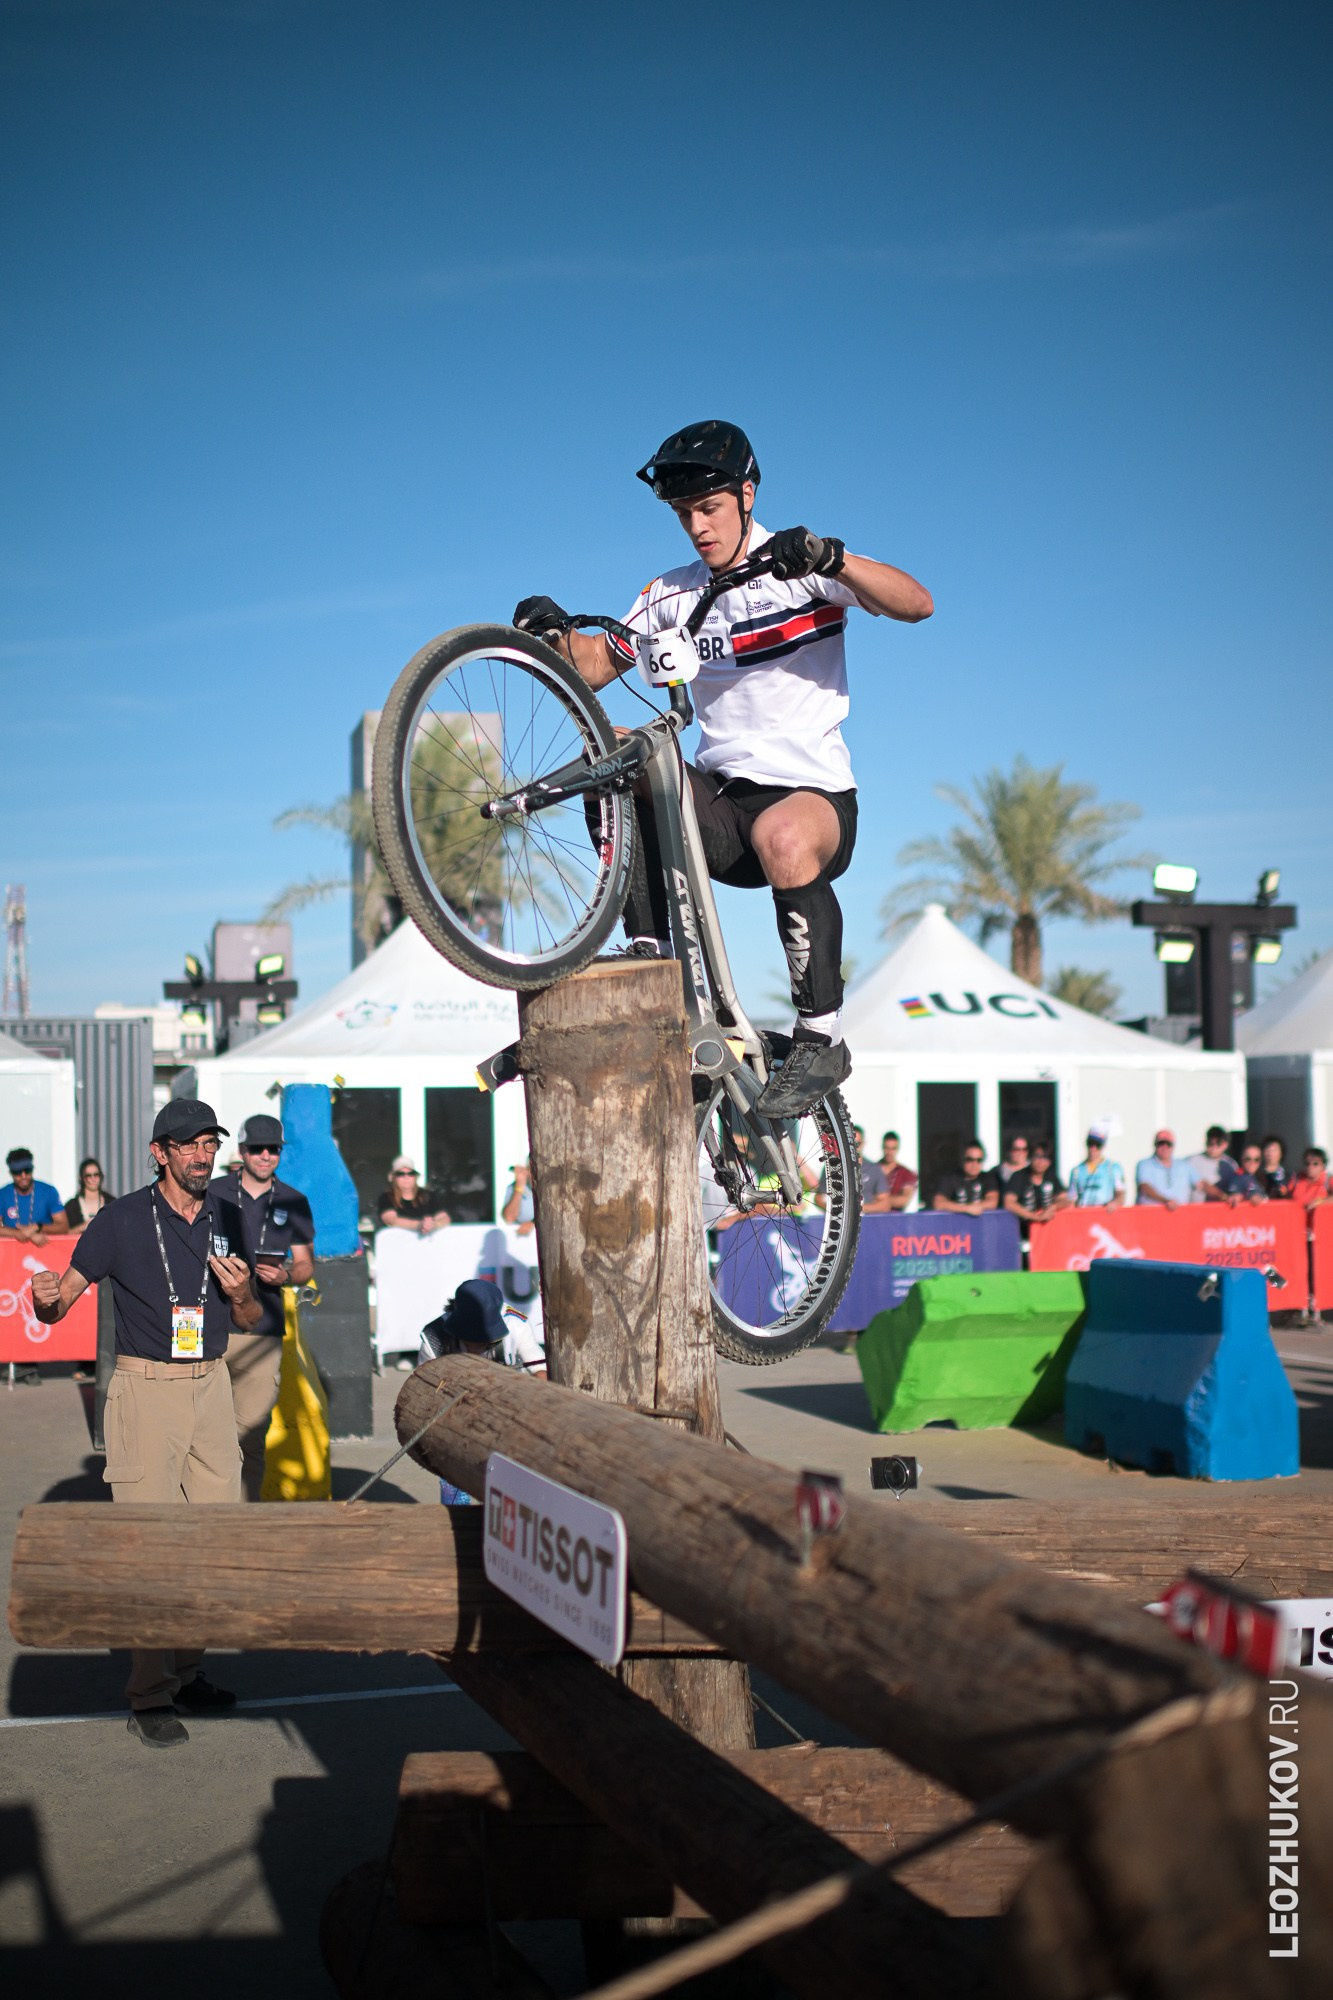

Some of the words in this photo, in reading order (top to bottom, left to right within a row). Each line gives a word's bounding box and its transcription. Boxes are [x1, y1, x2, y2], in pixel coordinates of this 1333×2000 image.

[693, 636, 726, 661] BR
[649, 652, 676, 674] 6C
[928, 991, 1061, 1021] UCI
[892, 1234, 971, 1256] RIYADH
[1203, 1226, 1276, 1249] RIYADH
[893, 1260, 937, 1277] 2025
[941, 1259, 973, 1275] UCI
[1206, 1252, 1243, 1266] 2025
[1248, 1250, 1276, 1264] UCI
[518, 1503, 614, 1610] TISSOT
